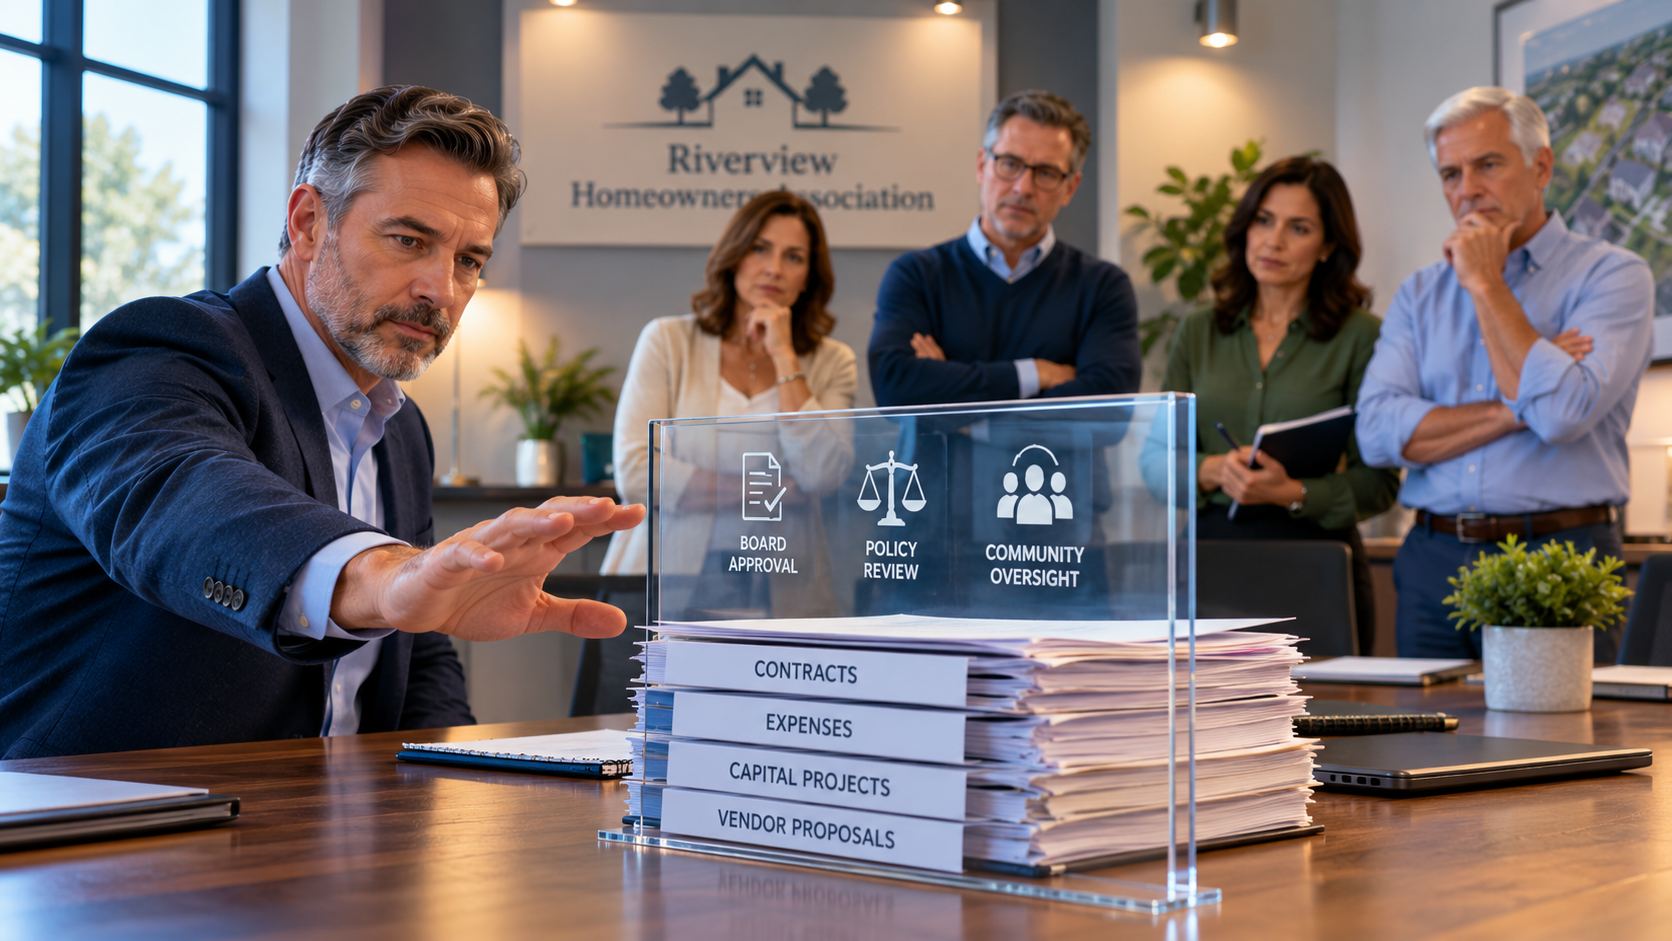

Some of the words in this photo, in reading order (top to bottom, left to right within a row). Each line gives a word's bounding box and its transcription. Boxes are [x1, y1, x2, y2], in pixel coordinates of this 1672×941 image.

[667, 143, 837, 174] Riverview
[775, 183, 935, 211] sociation
[739, 535, 787, 552] BOARD
[865, 540, 918, 558] POLICY
[985, 543, 1085, 564] COMMUNITY
[728, 556, 798, 574] APPROVAL
[863, 563, 919, 580] REVIEW
[990, 568, 1080, 588] OVERSIGHT
[754, 659, 858, 684] CONTRACTS
[766, 713, 852, 738] EXPENSES
[729, 761, 798, 786] CAPITAL
[802, 769, 890, 797] PROJECTS
[717, 808, 786, 835] VENDOR
[792, 817, 895, 849] PROPOSALS
